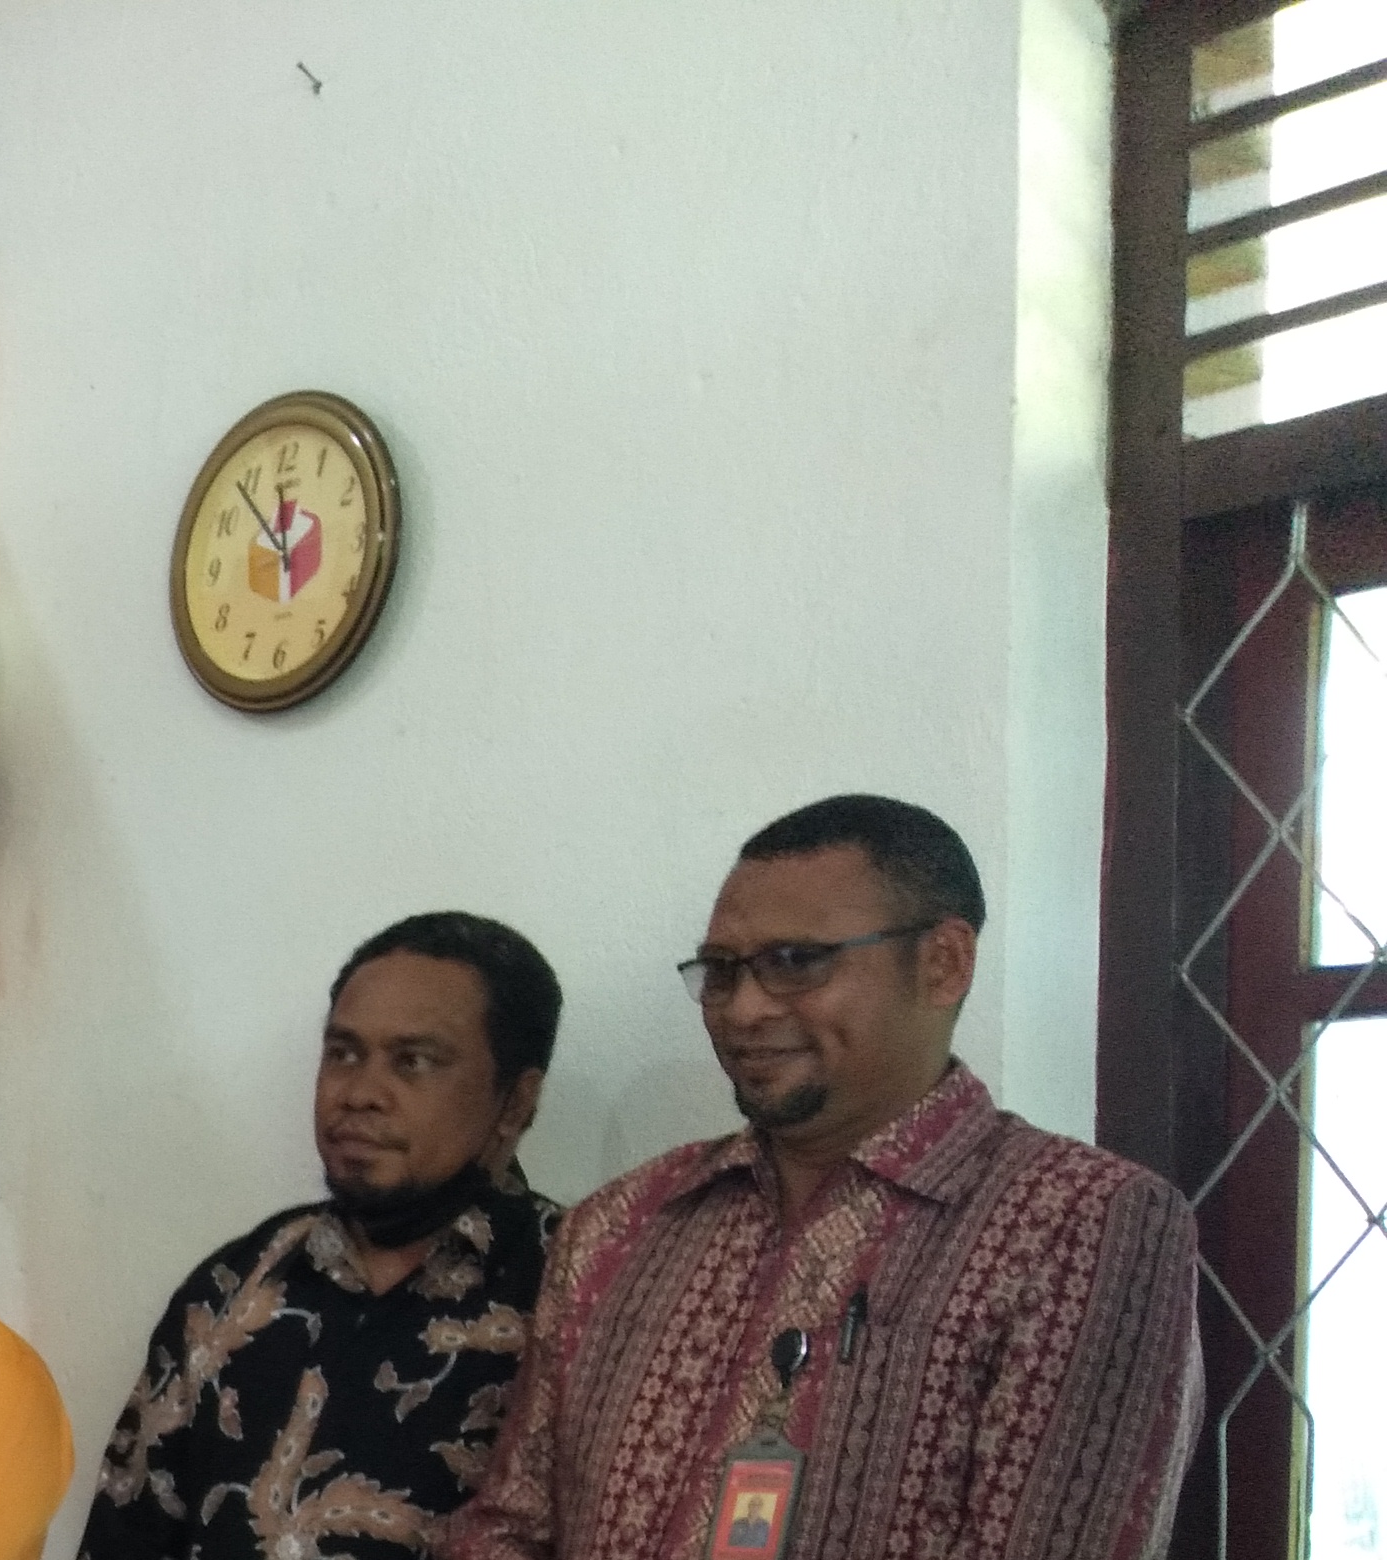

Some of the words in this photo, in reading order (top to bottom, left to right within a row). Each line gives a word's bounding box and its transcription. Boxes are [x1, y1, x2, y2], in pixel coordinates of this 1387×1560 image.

[278, 441, 300, 474] 12
[217, 504, 241, 539] 10
[209, 556, 222, 587] 9
[215, 603, 230, 633] 8
[243, 631, 258, 661] 7
[273, 640, 287, 669] 6
